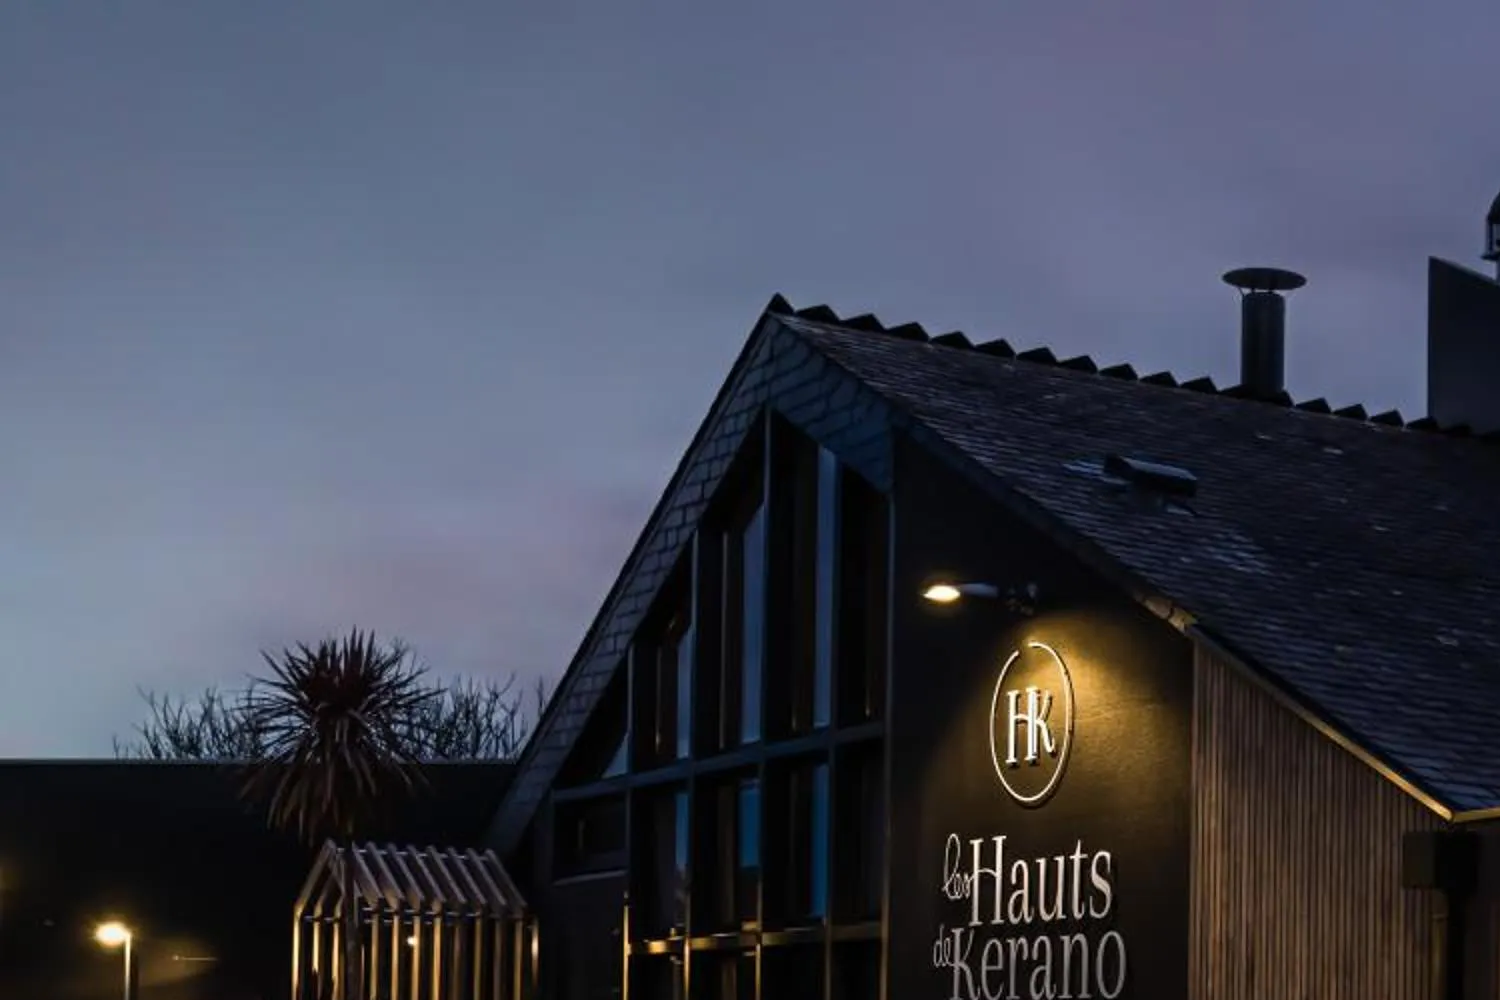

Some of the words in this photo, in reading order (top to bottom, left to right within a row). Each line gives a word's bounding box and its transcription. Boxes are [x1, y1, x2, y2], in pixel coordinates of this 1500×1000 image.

[1006, 686, 1055, 764] HK
[968, 834, 1113, 927] Hauts
[933, 924, 954, 968] de
